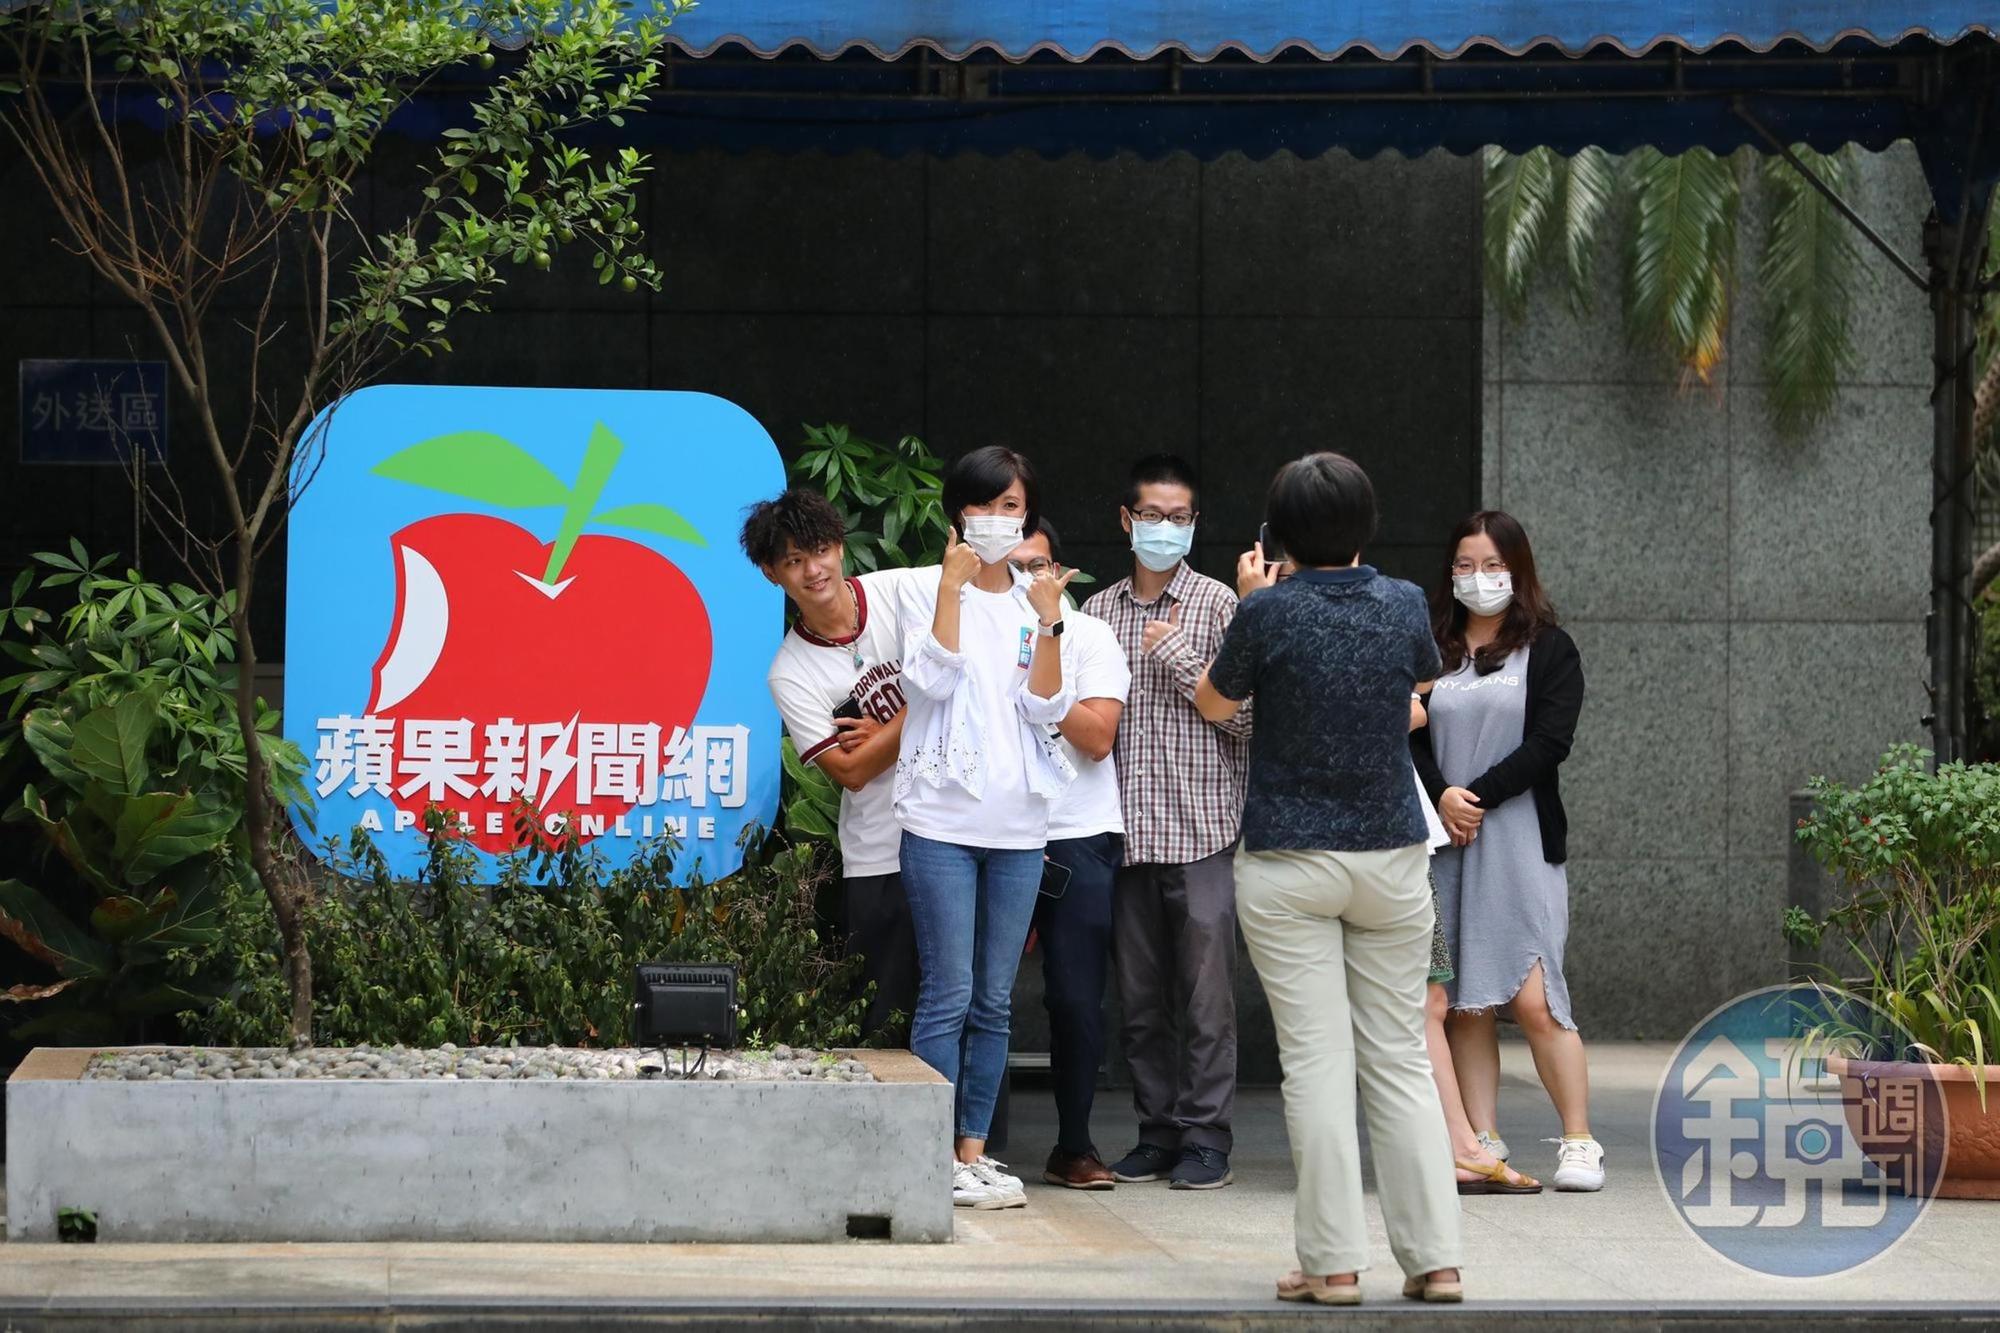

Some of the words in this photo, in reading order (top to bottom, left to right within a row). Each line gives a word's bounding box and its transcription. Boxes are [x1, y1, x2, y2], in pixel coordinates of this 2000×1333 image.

[32, 391, 159, 431] 外送區
[1461, 676, 1519, 691] JEANS
[315, 709, 750, 811] 蘋果新聞網
[360, 809, 503, 834] APLE
[544, 813, 715, 840] ONLINE
